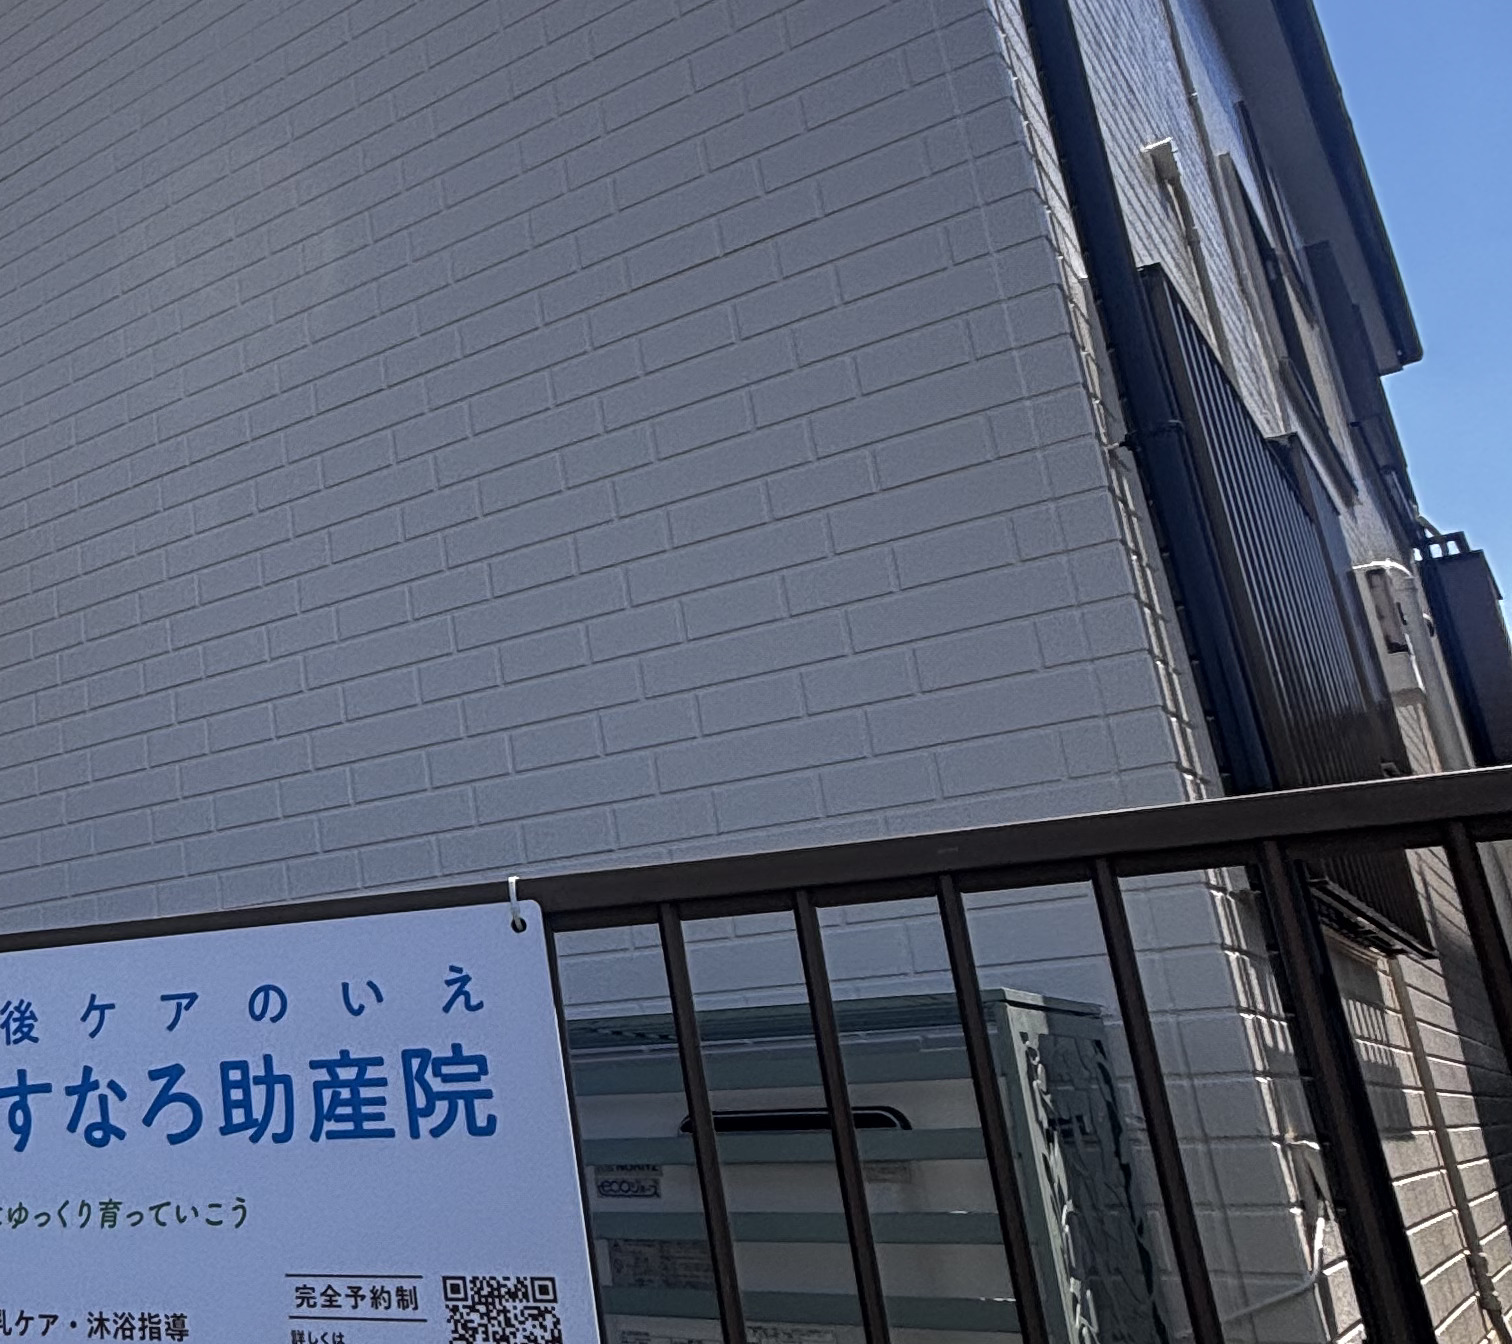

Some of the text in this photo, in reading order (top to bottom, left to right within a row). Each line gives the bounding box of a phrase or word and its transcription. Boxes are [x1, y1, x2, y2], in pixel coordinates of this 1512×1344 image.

[294, 1283, 420, 1311] 完全予約制
